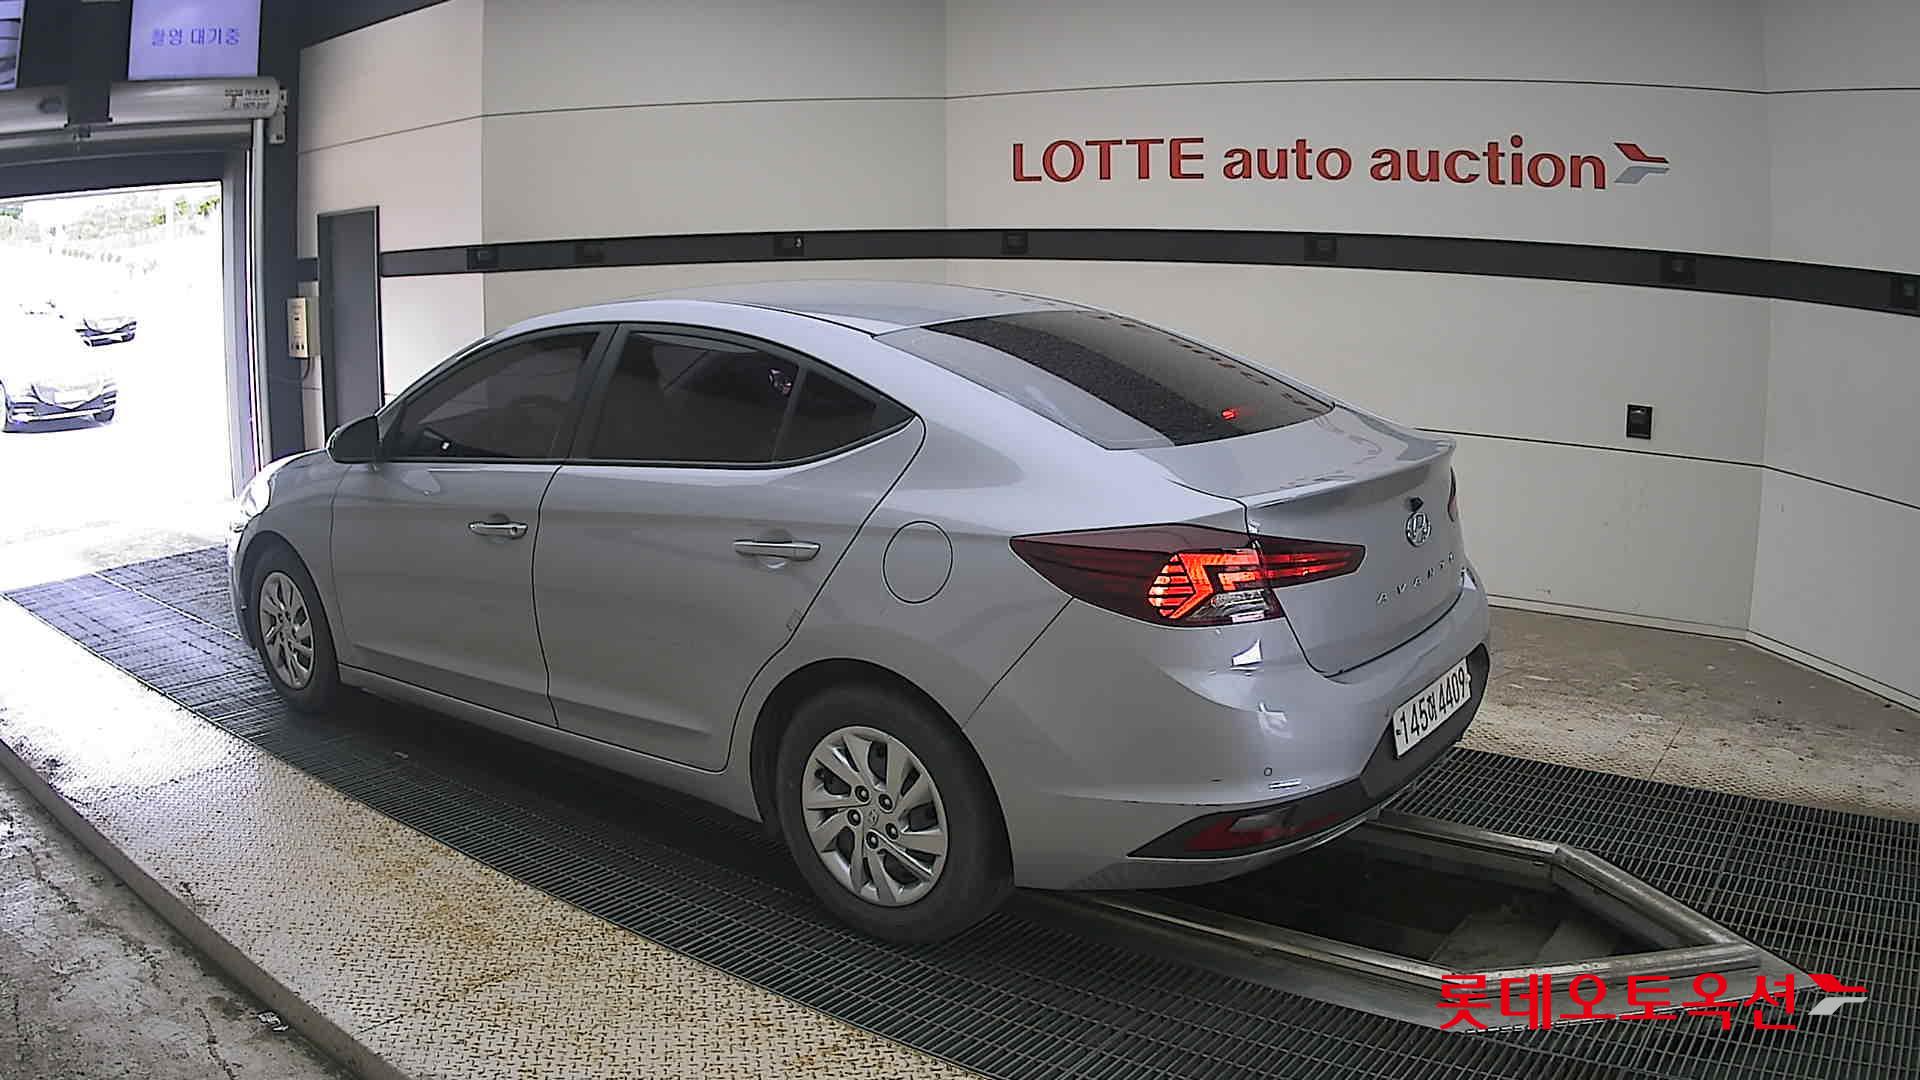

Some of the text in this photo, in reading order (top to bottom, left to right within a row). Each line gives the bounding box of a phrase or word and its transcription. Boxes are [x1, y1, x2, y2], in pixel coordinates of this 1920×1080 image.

[191, 27, 240, 45] 대기중
[1012, 134, 1606, 189] LOTTE auto auction
[1439, 667, 1465, 714] 4409
